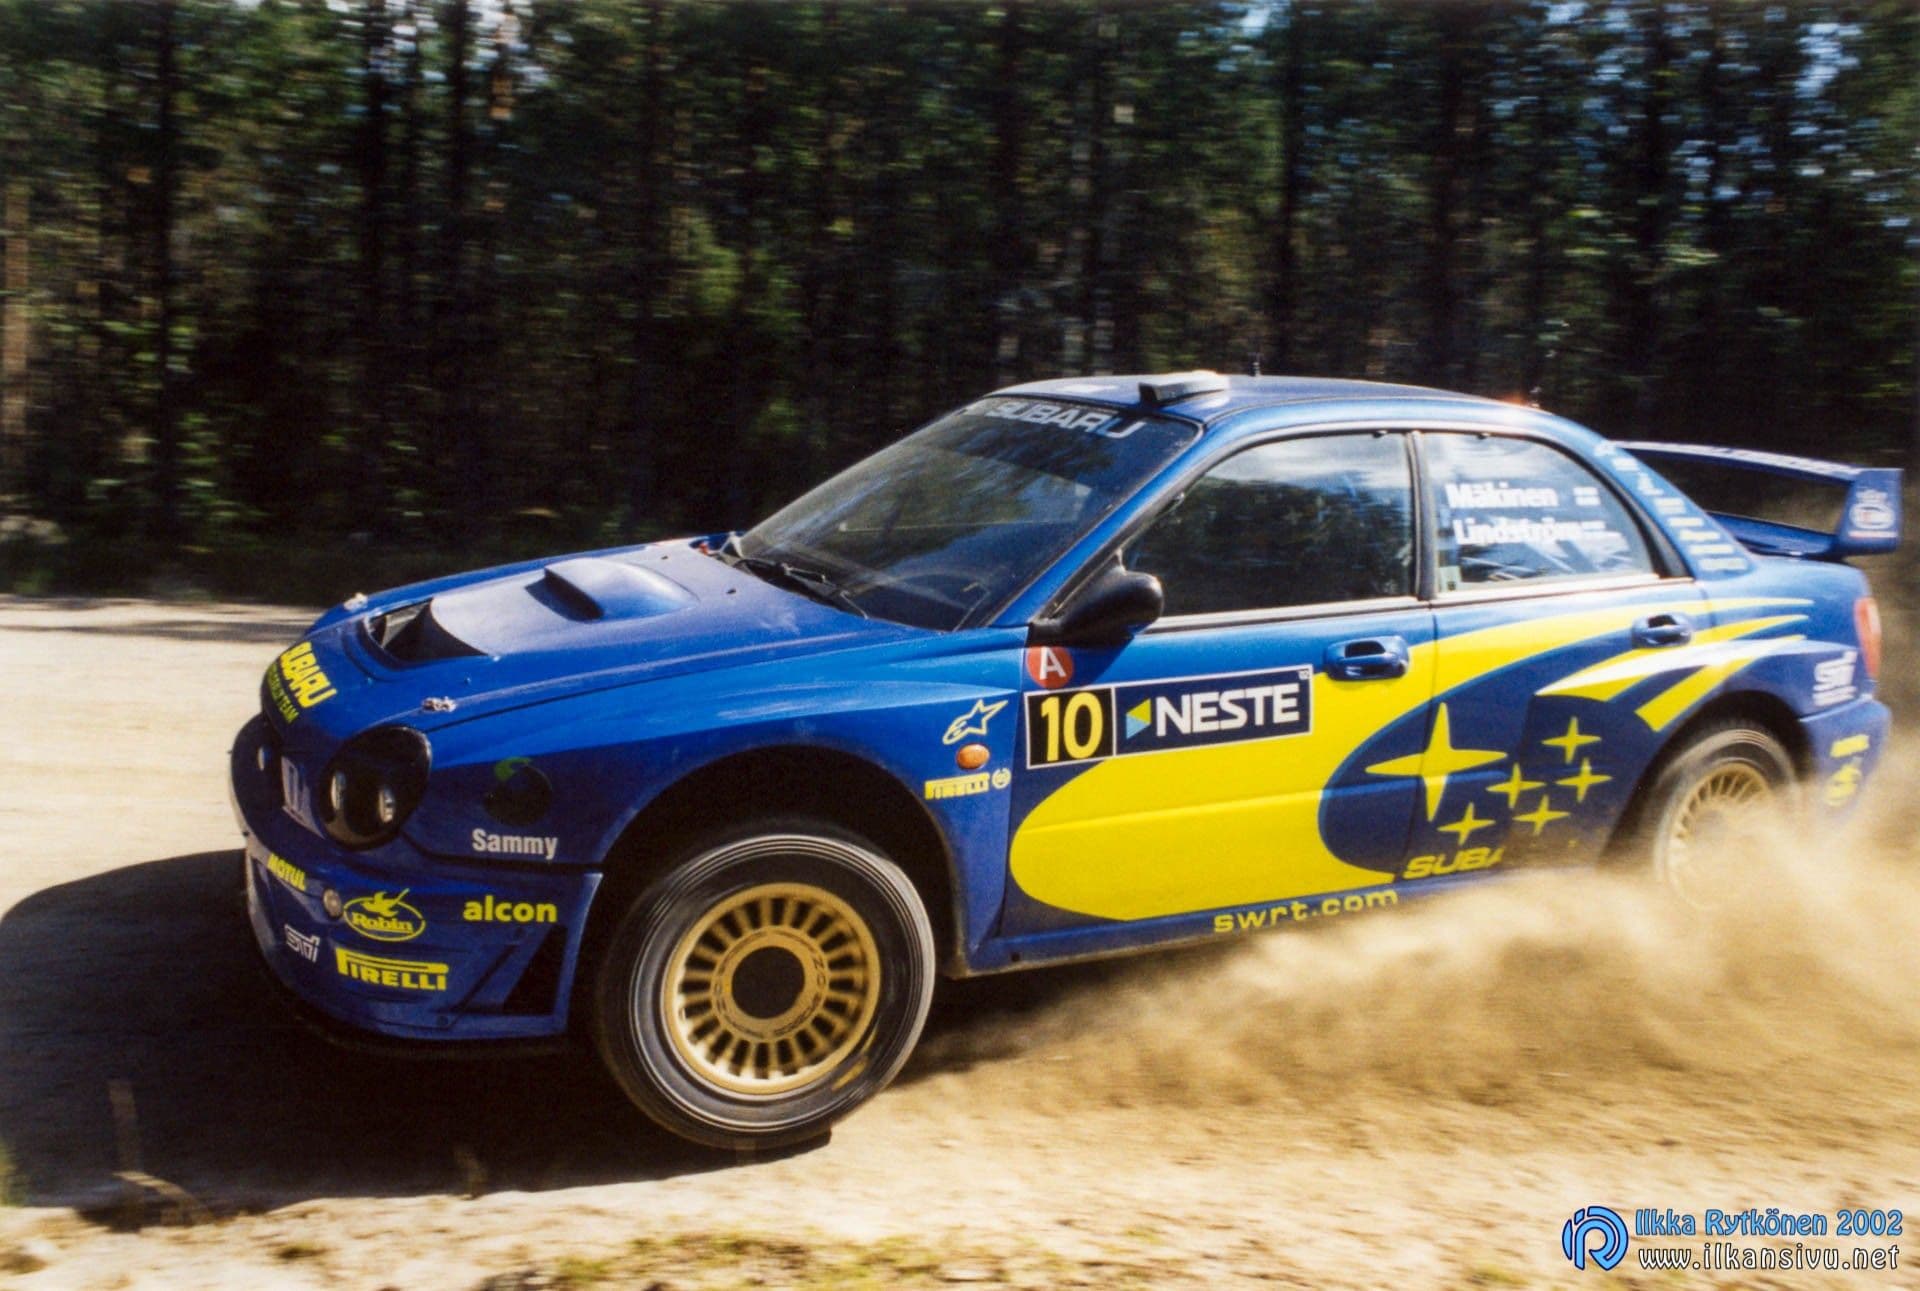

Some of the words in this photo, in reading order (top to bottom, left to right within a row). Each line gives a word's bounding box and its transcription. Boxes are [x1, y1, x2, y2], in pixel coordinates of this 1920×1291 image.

[985, 401, 1147, 438] SUBARU
[1037, 646, 1067, 681] A
[1040, 691, 1104, 762] 10
[1156, 683, 1300, 737] NESTE
[472, 828, 558, 860] Sammy
[267, 853, 305, 892] MOTUL
[351, 911, 415, 935] Robin
[463, 895, 558, 923] alcon
[1213, 889, 1399, 933] swrt.com
[335, 947, 449, 992] PIRELLI
